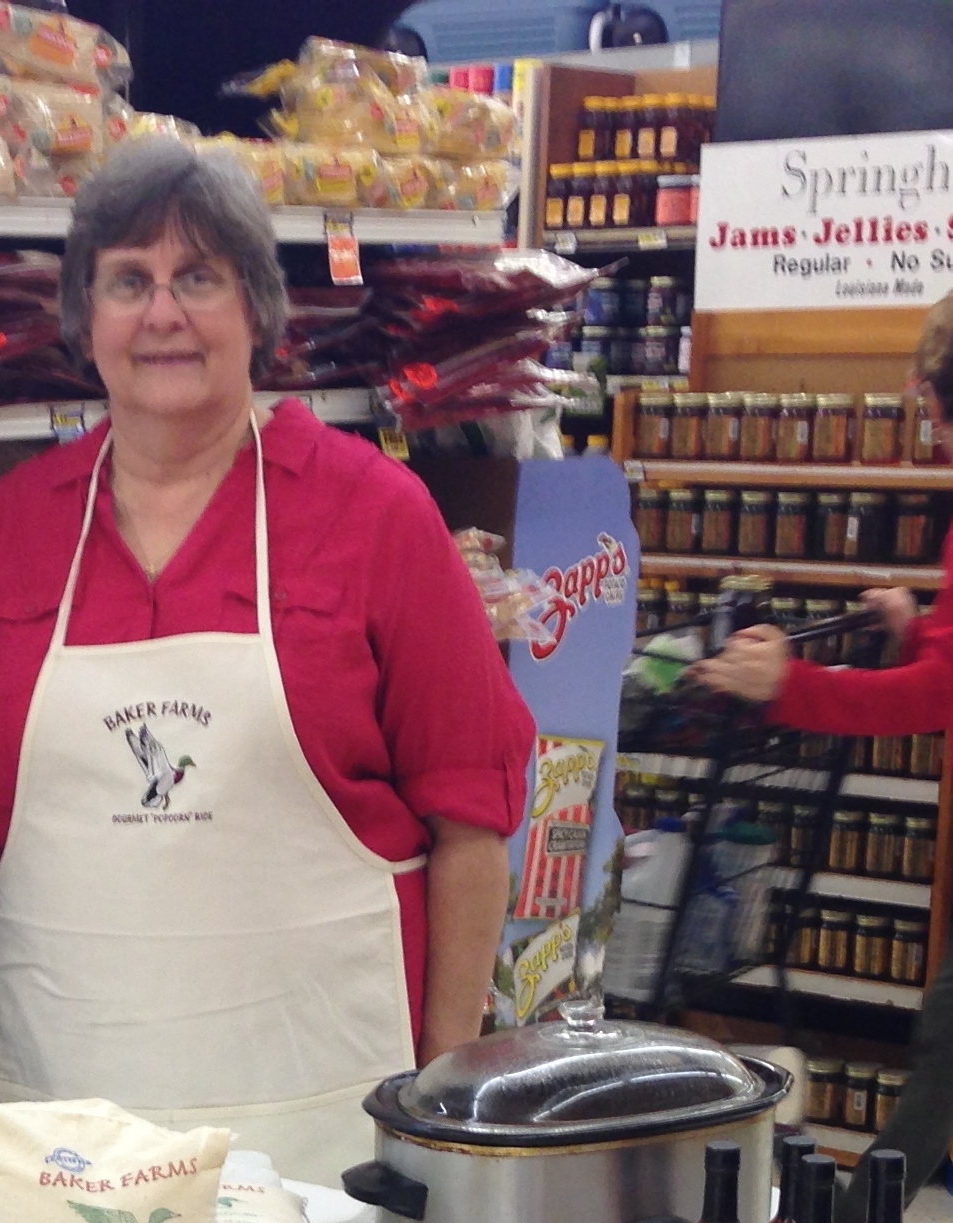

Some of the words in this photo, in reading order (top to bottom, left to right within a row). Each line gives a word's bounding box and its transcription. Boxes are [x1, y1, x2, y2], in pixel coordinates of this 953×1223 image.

[781, 144, 951, 216] Springh
[709, 221, 796, 249] Jams
[813, 215, 929, 245] Jellies
[773, 253, 850, 278] Regular
[890, 250, 920, 272] No
[103, 701, 157, 732] BAKER
[161, 700, 211, 727] FARMS
[39, 1170, 115, 1193] BAKER
[120, 1158, 197, 1187] FARMS
